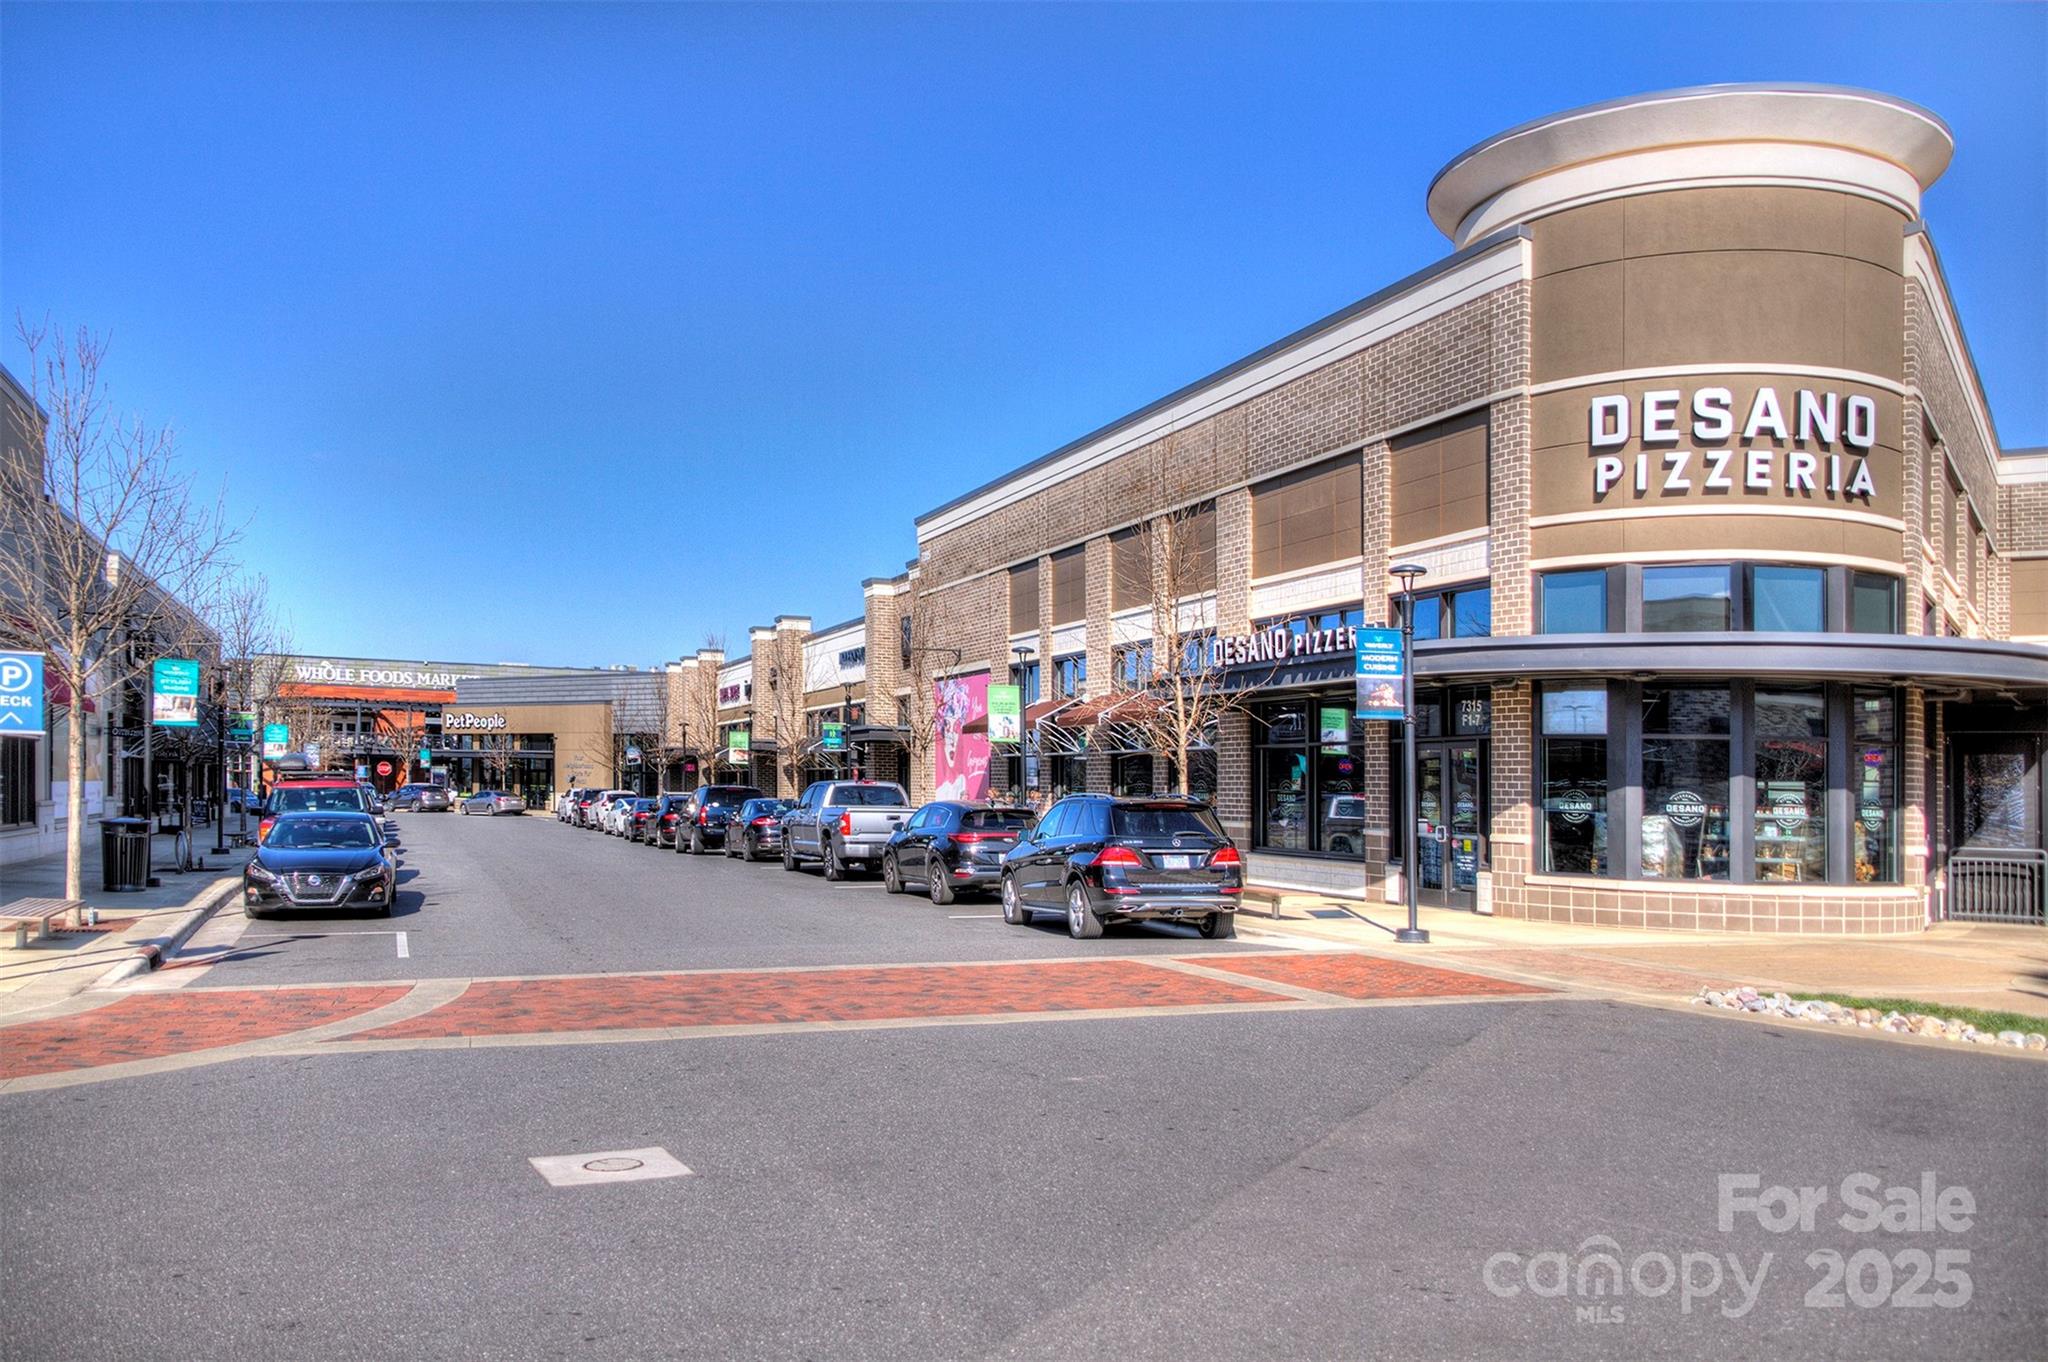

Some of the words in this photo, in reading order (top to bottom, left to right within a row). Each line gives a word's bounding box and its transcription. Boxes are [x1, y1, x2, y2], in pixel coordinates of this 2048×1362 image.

[1590, 386, 1876, 448] DESANO
[1595, 450, 1877, 497] PIZZERIA
[1213, 628, 1287, 666] DESANO
[1294, 625, 1376, 656] PIZZER
[295, 663, 355, 682] WHOLE
[360, 669, 413, 685] FOODS
[416, 672, 480, 686] MARK
[0, 695, 33, 706] ECK
[1461, 700, 1482, 712] 7315
[445, 712, 506, 731] PetPeople
[1558, 802, 1592, 810] DESANO
[1665, 804, 1705, 813] DESANO
[1772, 807, 1806, 815] DESANO
